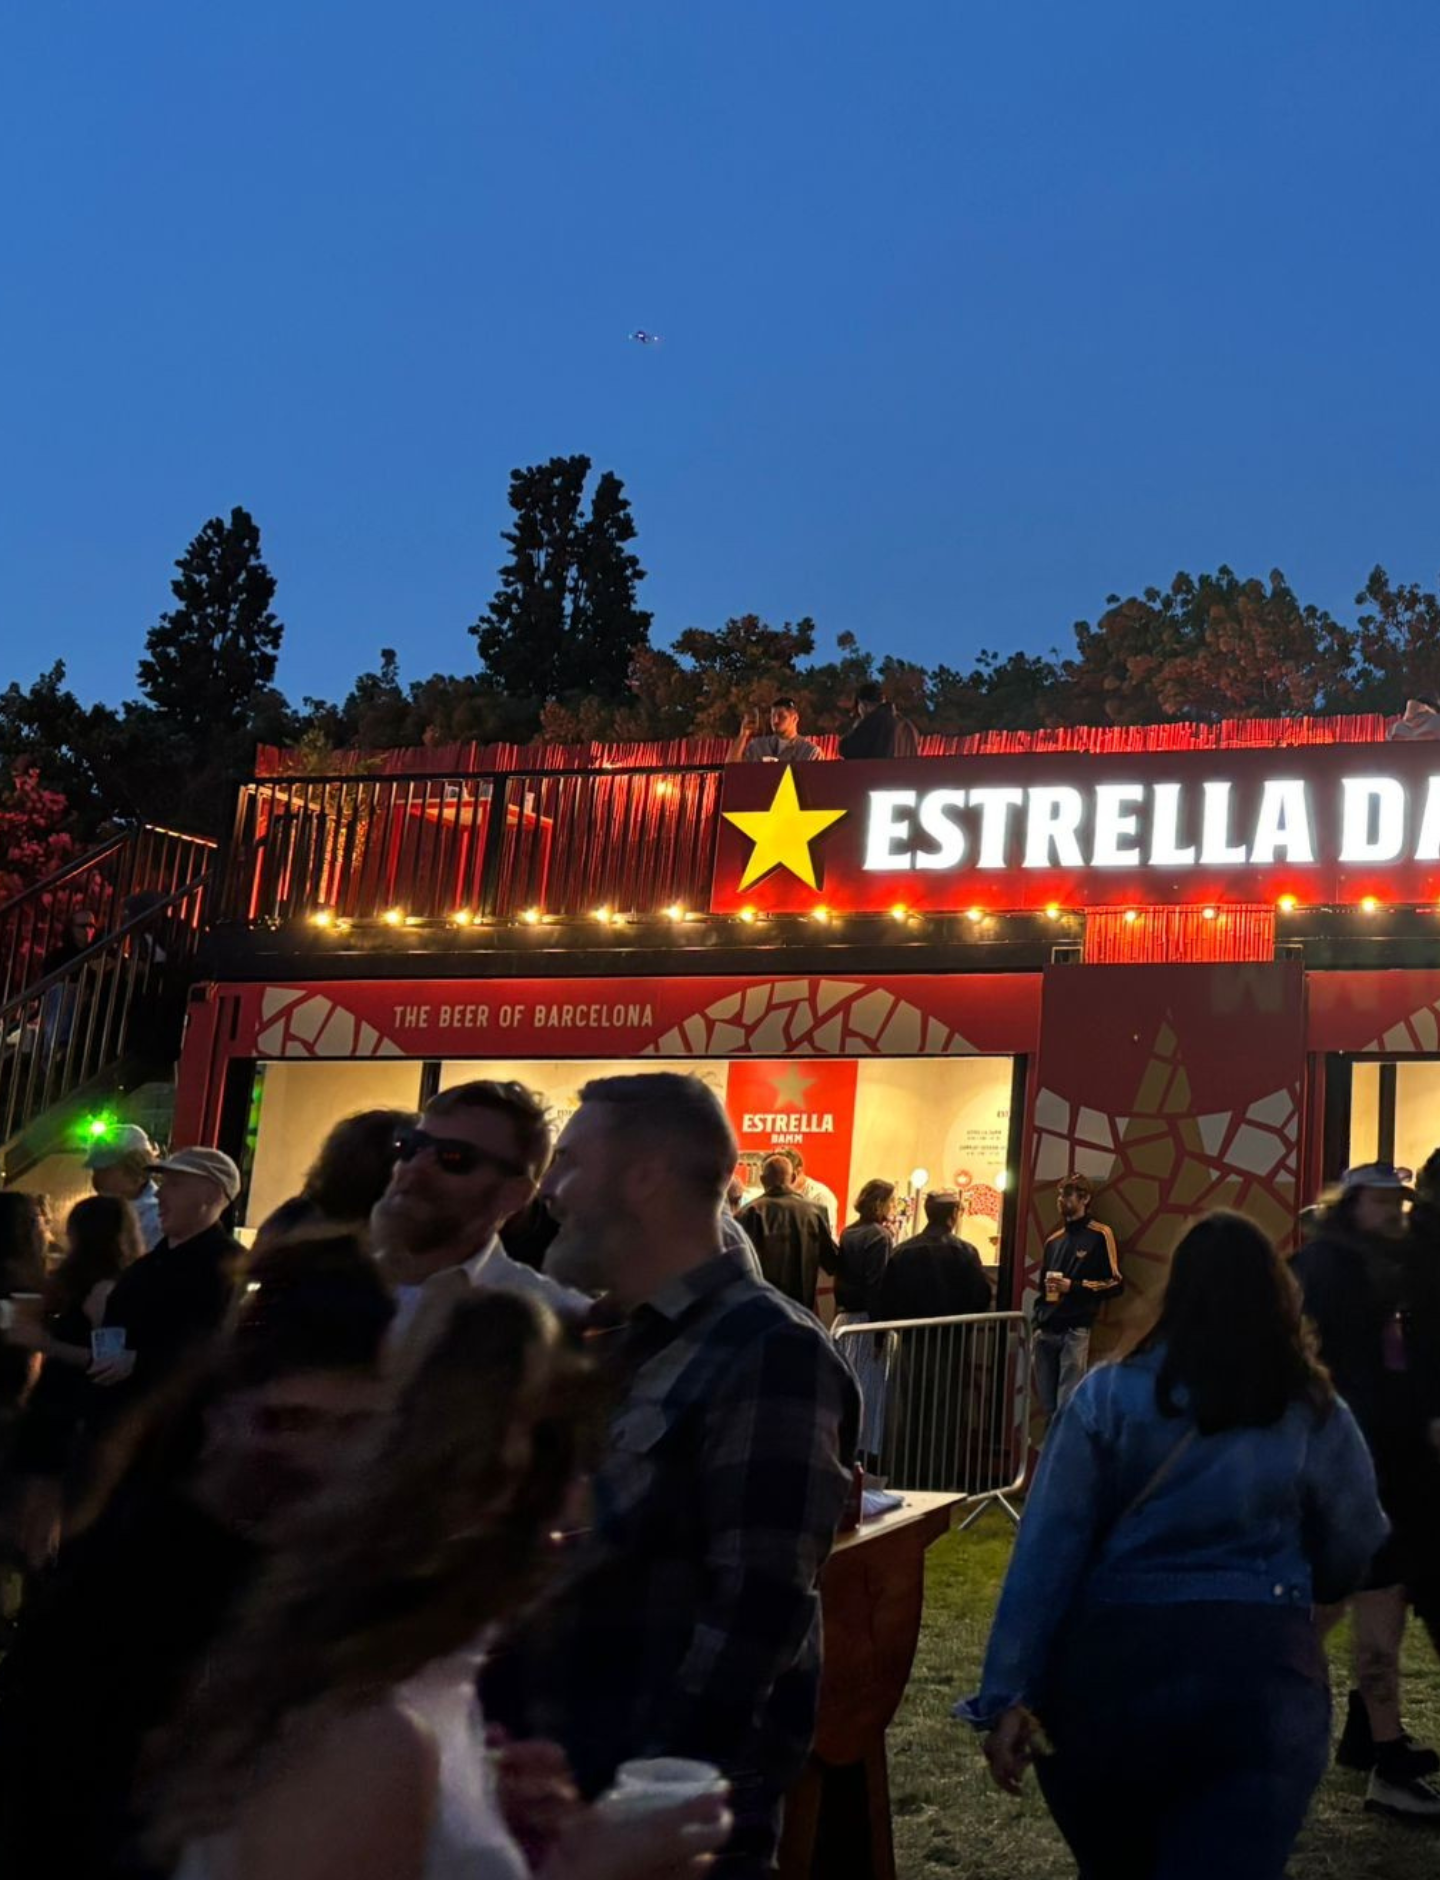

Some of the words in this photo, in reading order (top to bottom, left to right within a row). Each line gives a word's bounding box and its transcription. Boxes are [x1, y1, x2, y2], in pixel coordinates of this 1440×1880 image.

[863, 780, 1316, 871] ESTRELLA
[394, 1006, 430, 1027] THE
[439, 1006, 489, 1027] BEER
[499, 1006, 525, 1027] OF
[534, 1004, 653, 1027] BARCELONA
[742, 1113, 834, 1133] ESTRELLA
[771, 1133, 803, 1144] DAMM
